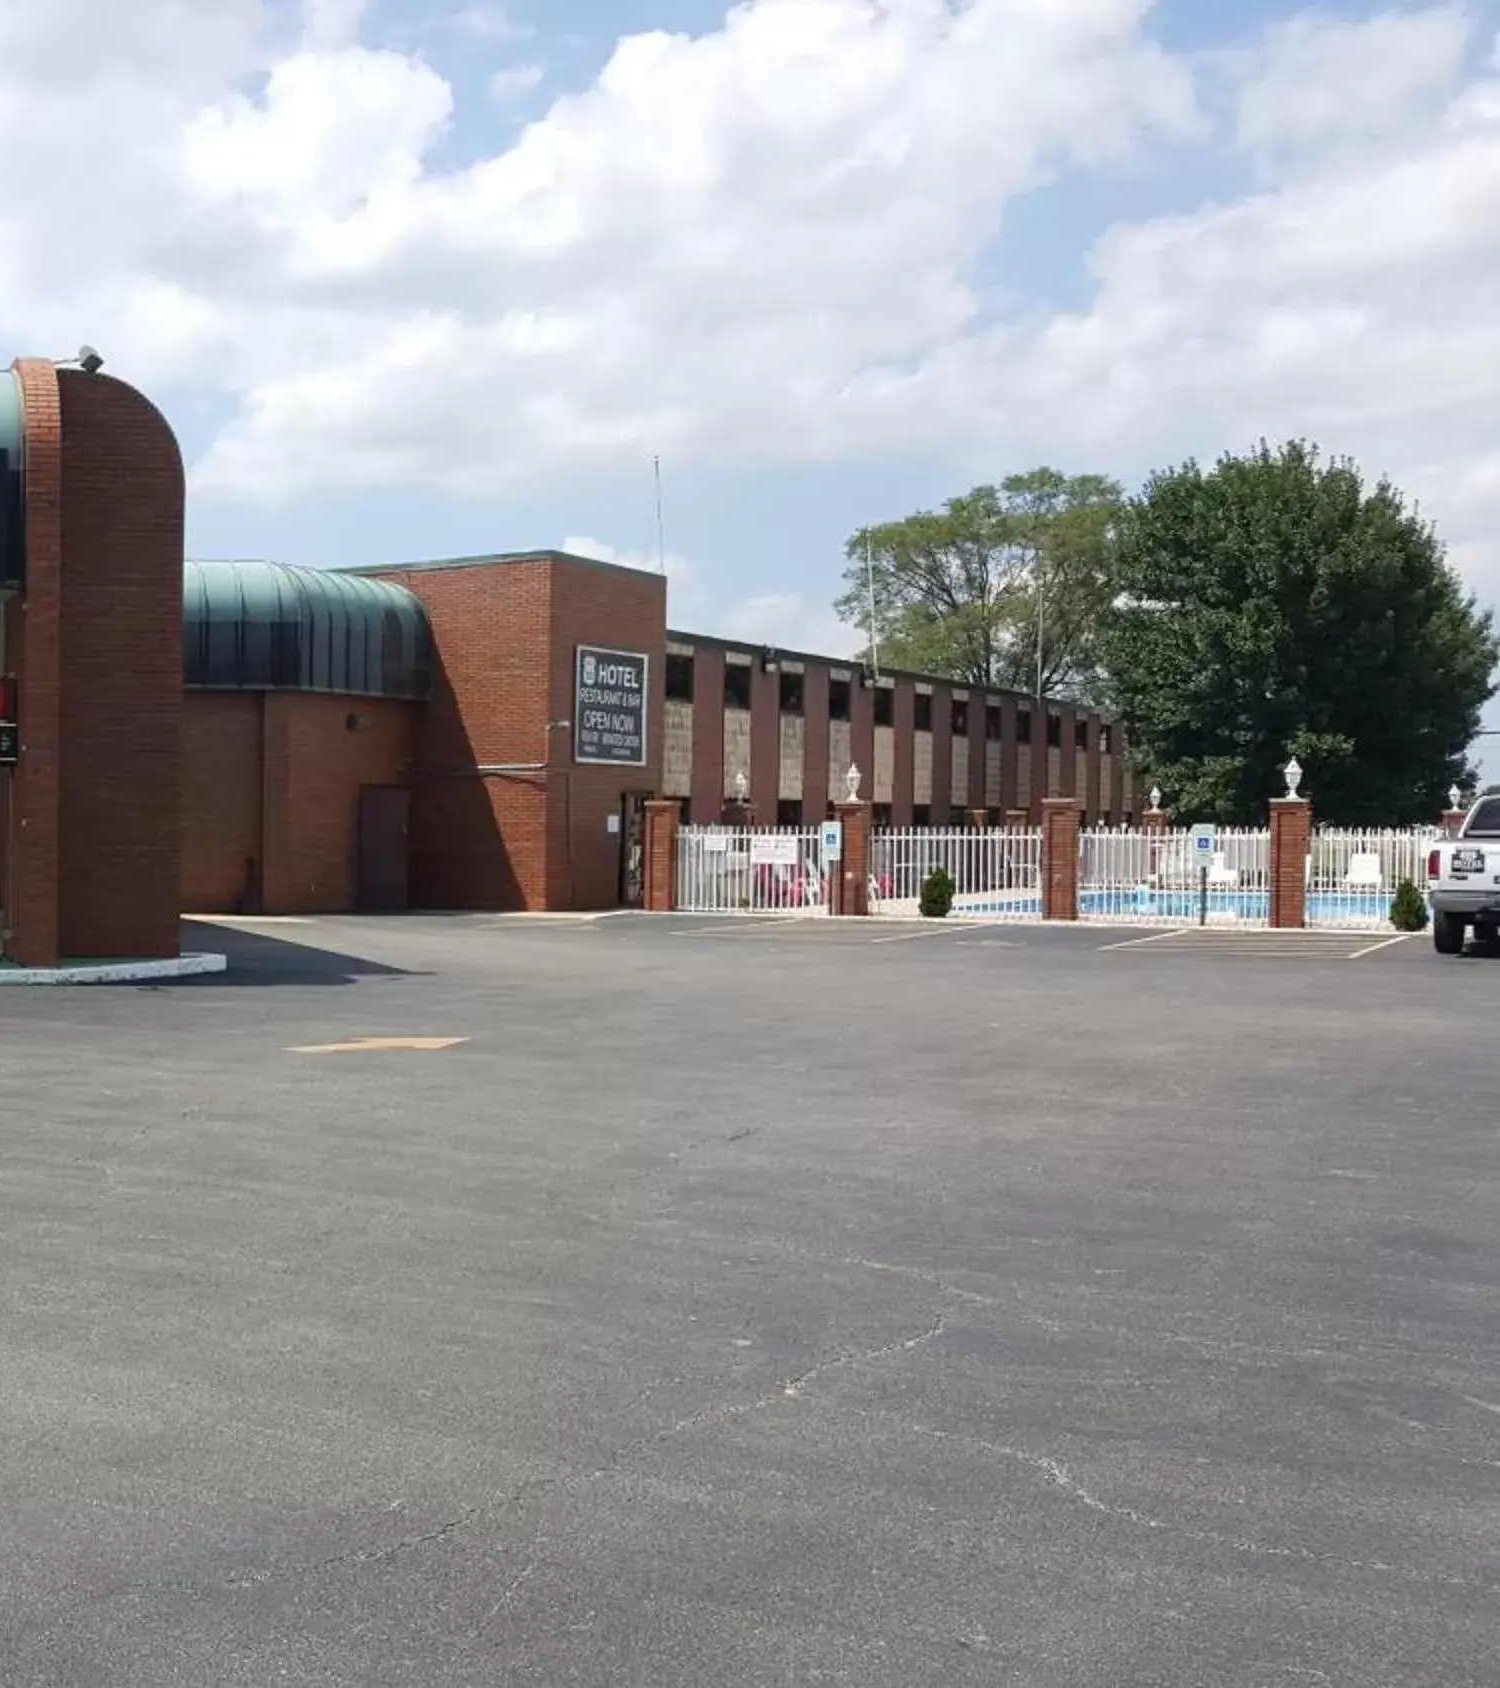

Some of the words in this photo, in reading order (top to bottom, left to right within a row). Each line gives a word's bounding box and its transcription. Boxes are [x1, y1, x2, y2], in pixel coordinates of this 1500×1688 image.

[598, 664, 639, 688] HOTEL
[583, 709, 610, 730] OPEN
[611, 713, 635, 733] NOW
